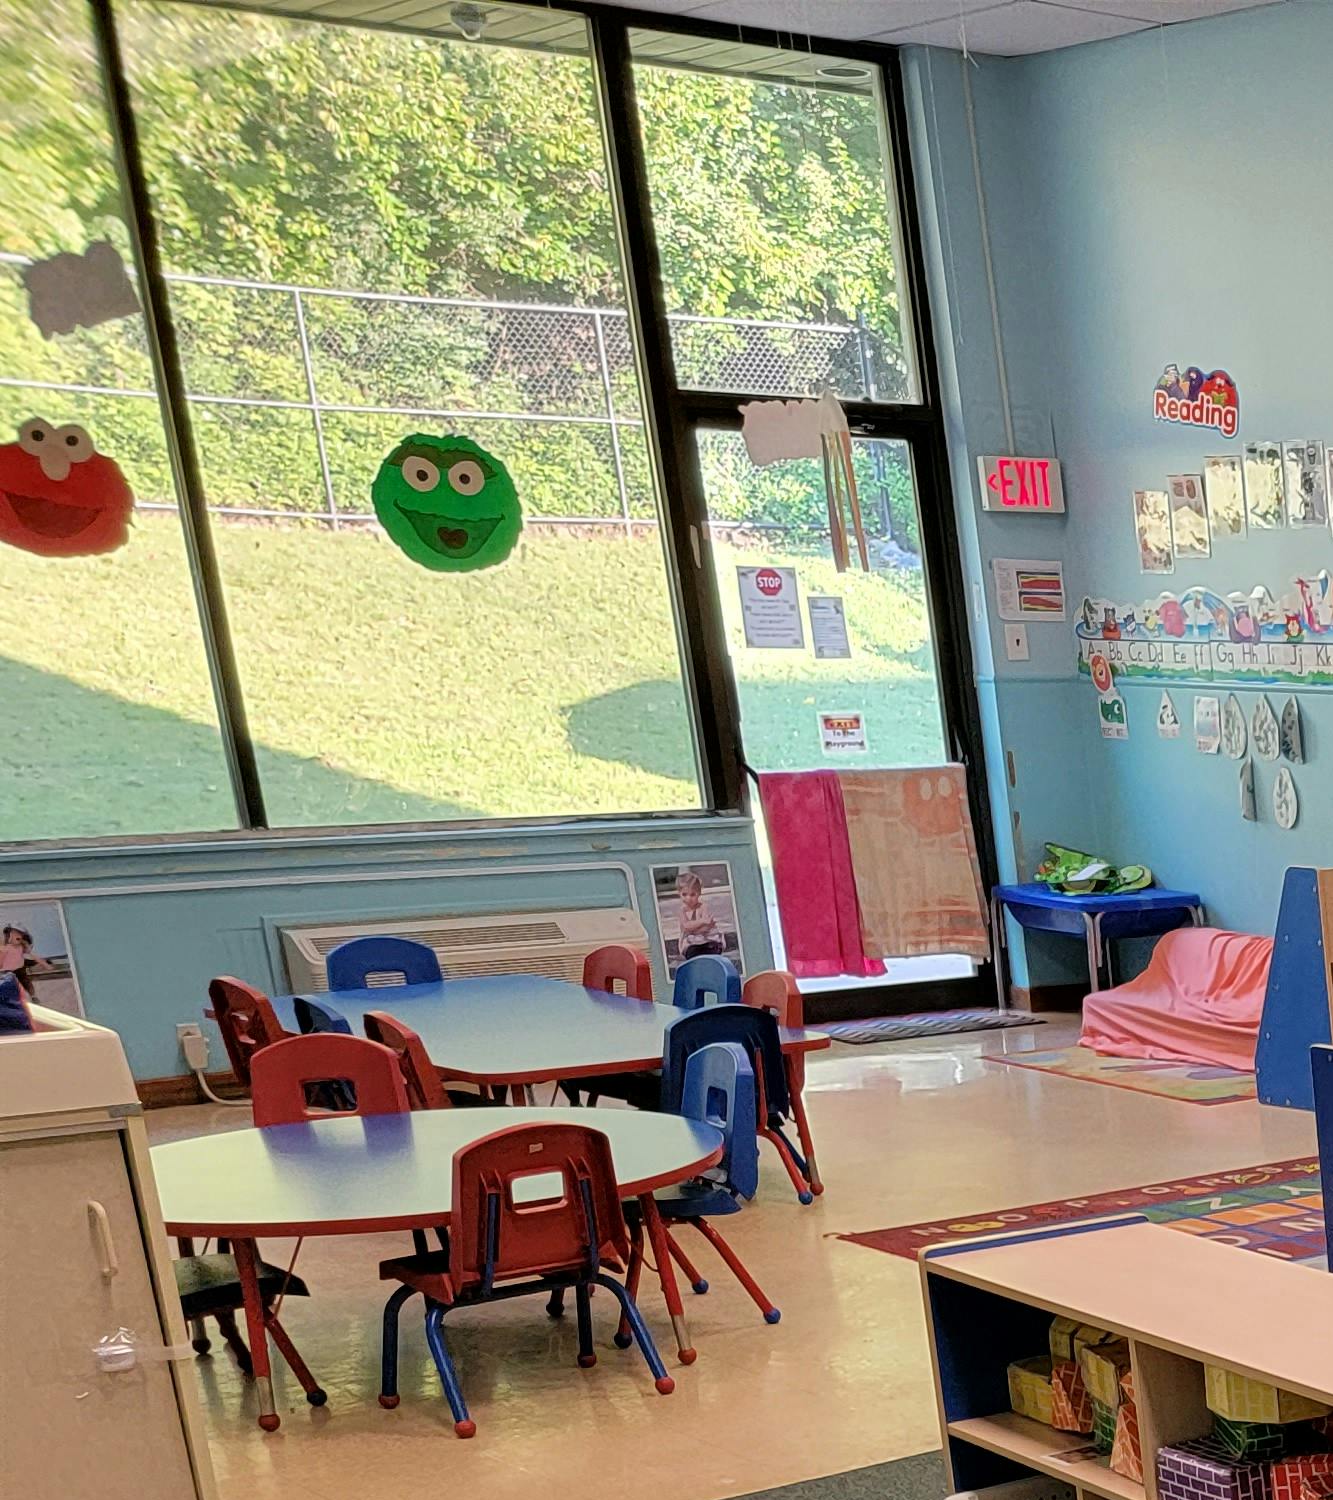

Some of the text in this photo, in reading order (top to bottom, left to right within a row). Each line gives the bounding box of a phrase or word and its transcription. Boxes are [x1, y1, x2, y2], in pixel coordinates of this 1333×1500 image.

[1155, 391, 1236, 436] Reading
[998, 459, 1051, 507] EXIT
[757, 576, 781, 588] STOP
[1109, 643, 1122, 661] Bb
[1128, 643, 1143, 662] Cc
[1147, 643, 1163, 663] Dd
[1217, 643, 1234, 672] Gg
[1290, 645, 1303, 674] Jj
[1315, 645, 1332, 667] Kk
